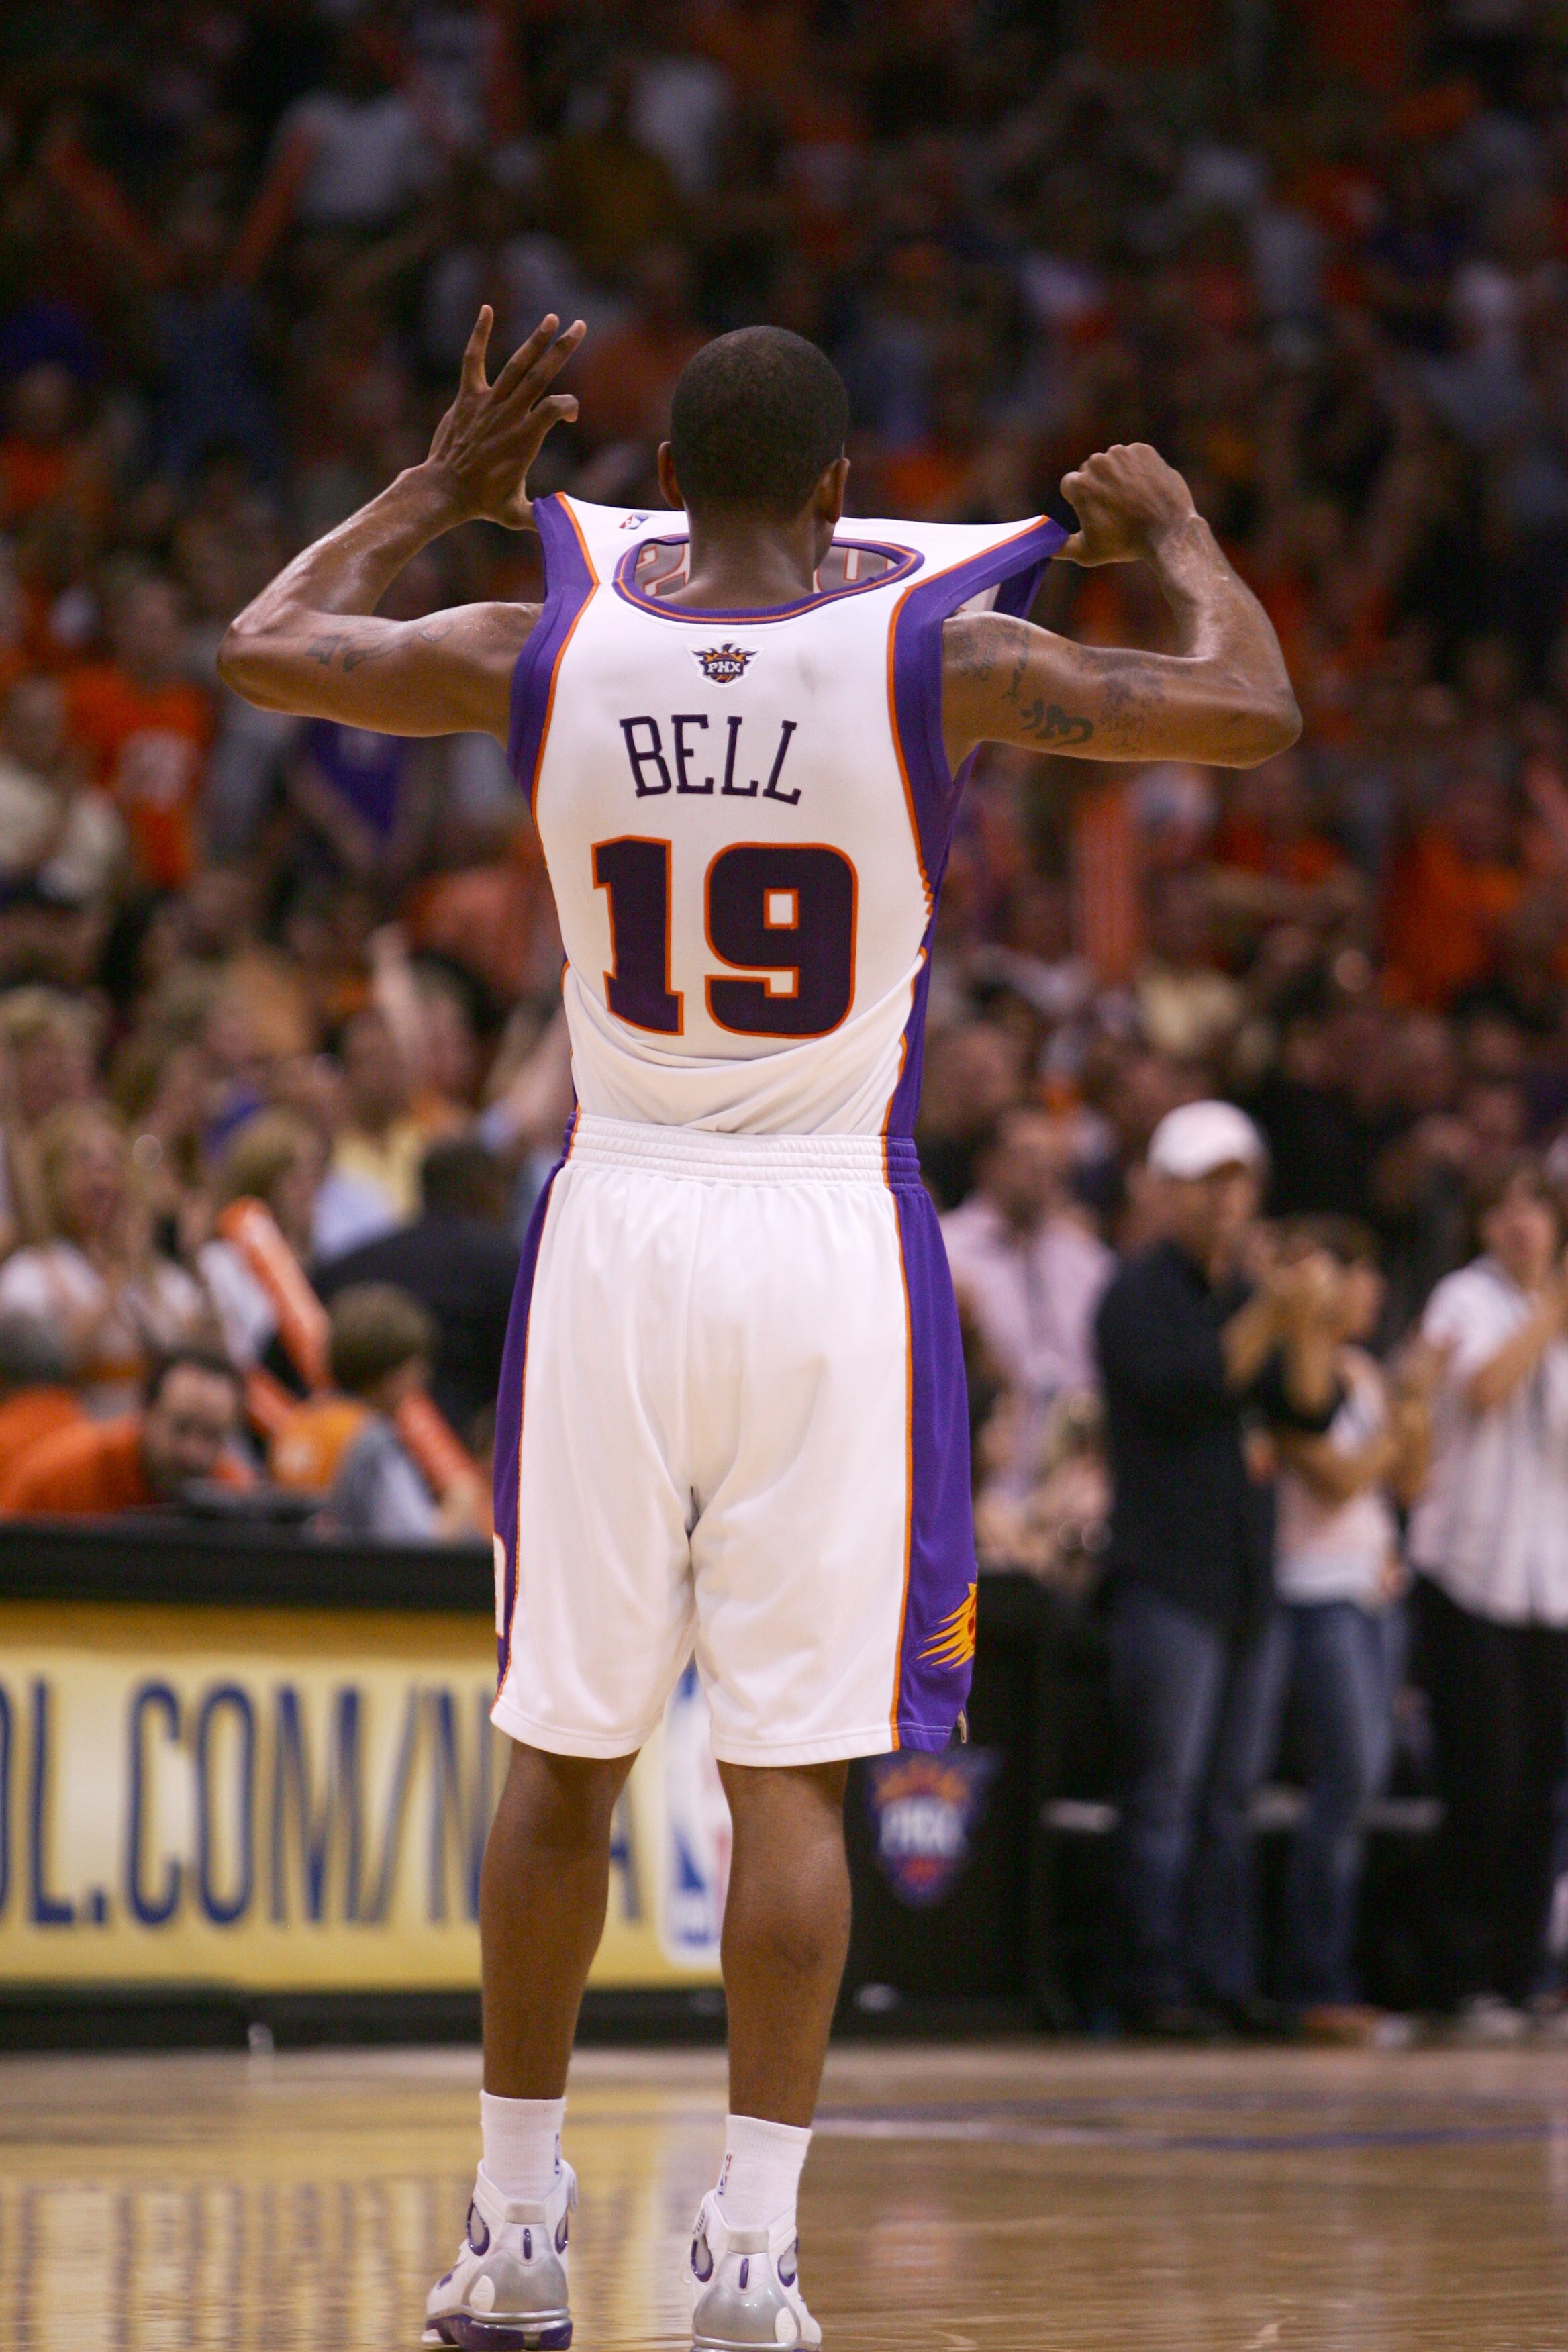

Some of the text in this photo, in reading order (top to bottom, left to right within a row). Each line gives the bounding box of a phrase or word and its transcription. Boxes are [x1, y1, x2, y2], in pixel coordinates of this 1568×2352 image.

[707, 660, 741, 673] PHX
[619, 714, 801, 805] BELL
[591, 834, 858, 1039] 19
